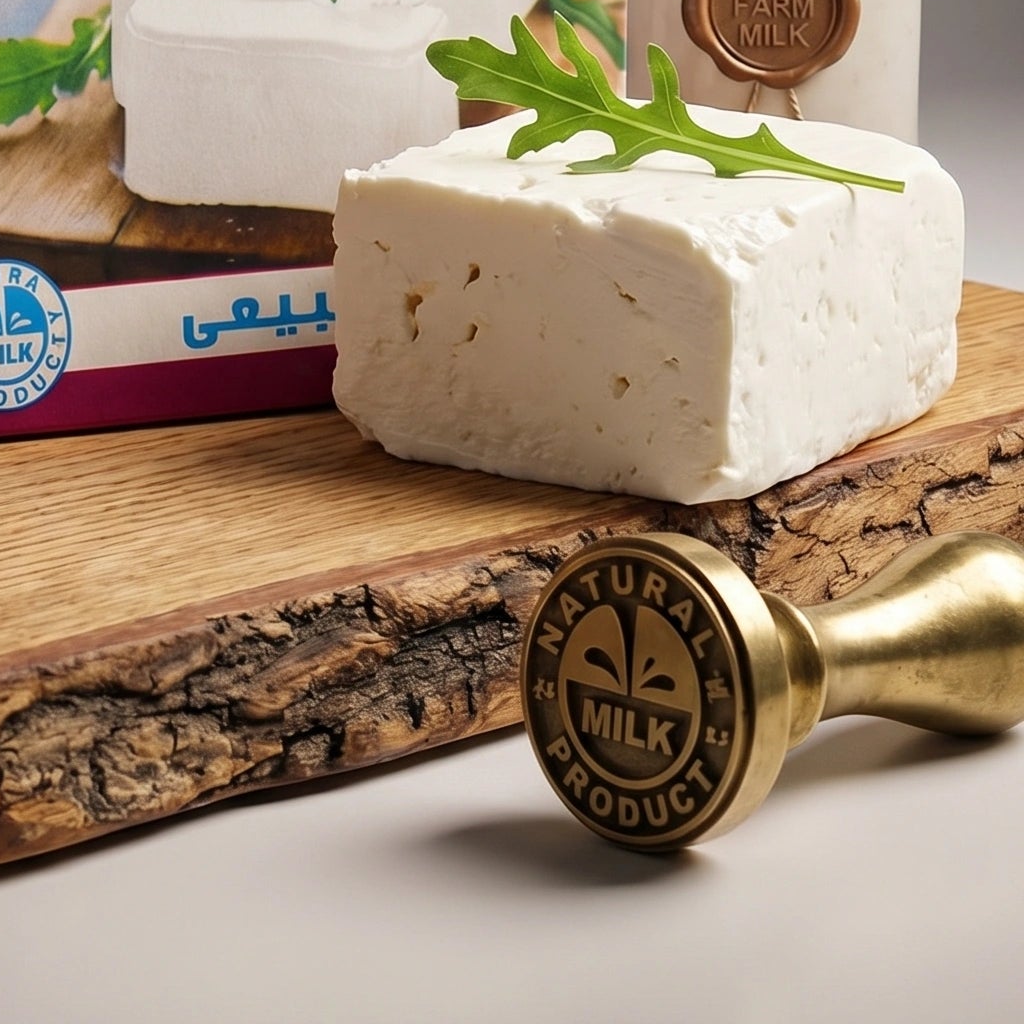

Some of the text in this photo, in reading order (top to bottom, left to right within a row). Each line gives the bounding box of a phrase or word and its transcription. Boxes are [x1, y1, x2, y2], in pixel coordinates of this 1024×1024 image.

[738, 23, 811, 48] MILK
[182, 291, 335, 349] بيعى
[537, 564, 715, 659] NATURAL
[581, 698, 676, 756] MILK
[546, 736, 714, 826] PRODUCT
